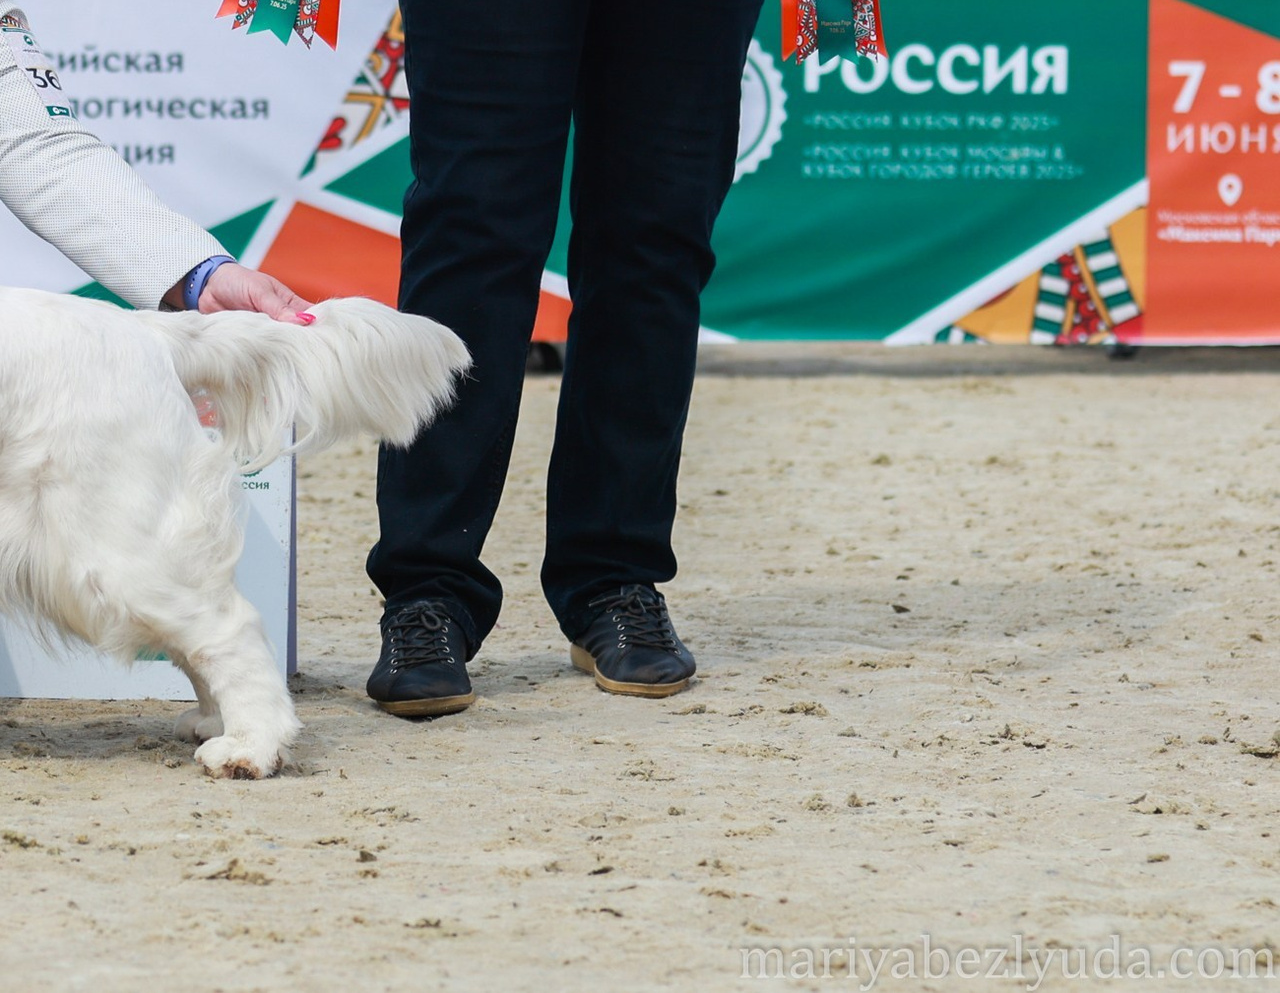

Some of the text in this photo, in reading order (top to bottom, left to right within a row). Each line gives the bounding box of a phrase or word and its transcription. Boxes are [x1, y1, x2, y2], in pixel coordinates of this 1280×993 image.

[56, 45, 184, 74] ийская
[803, 43, 1069, 95] РОССИЯ
[1168, 60, 1207, 114] 7
[1255, 60, 1280, 115] 8
[69, 96, 270, 120] логическая
[899, 112, 960, 130] КУБОК
[967, 112, 1005, 130] РКФ
[899, 143, 960, 160] КУБОК
[967, 143, 1048, 161] МОСКВЫ
[802, 162, 862, 179] КУБОК
[869, 162, 957, 179] ГОРОДОВ
[963, 162, 1030, 179] ГЕРОЕВ
[241, 481, 270, 490] ССИЯ
